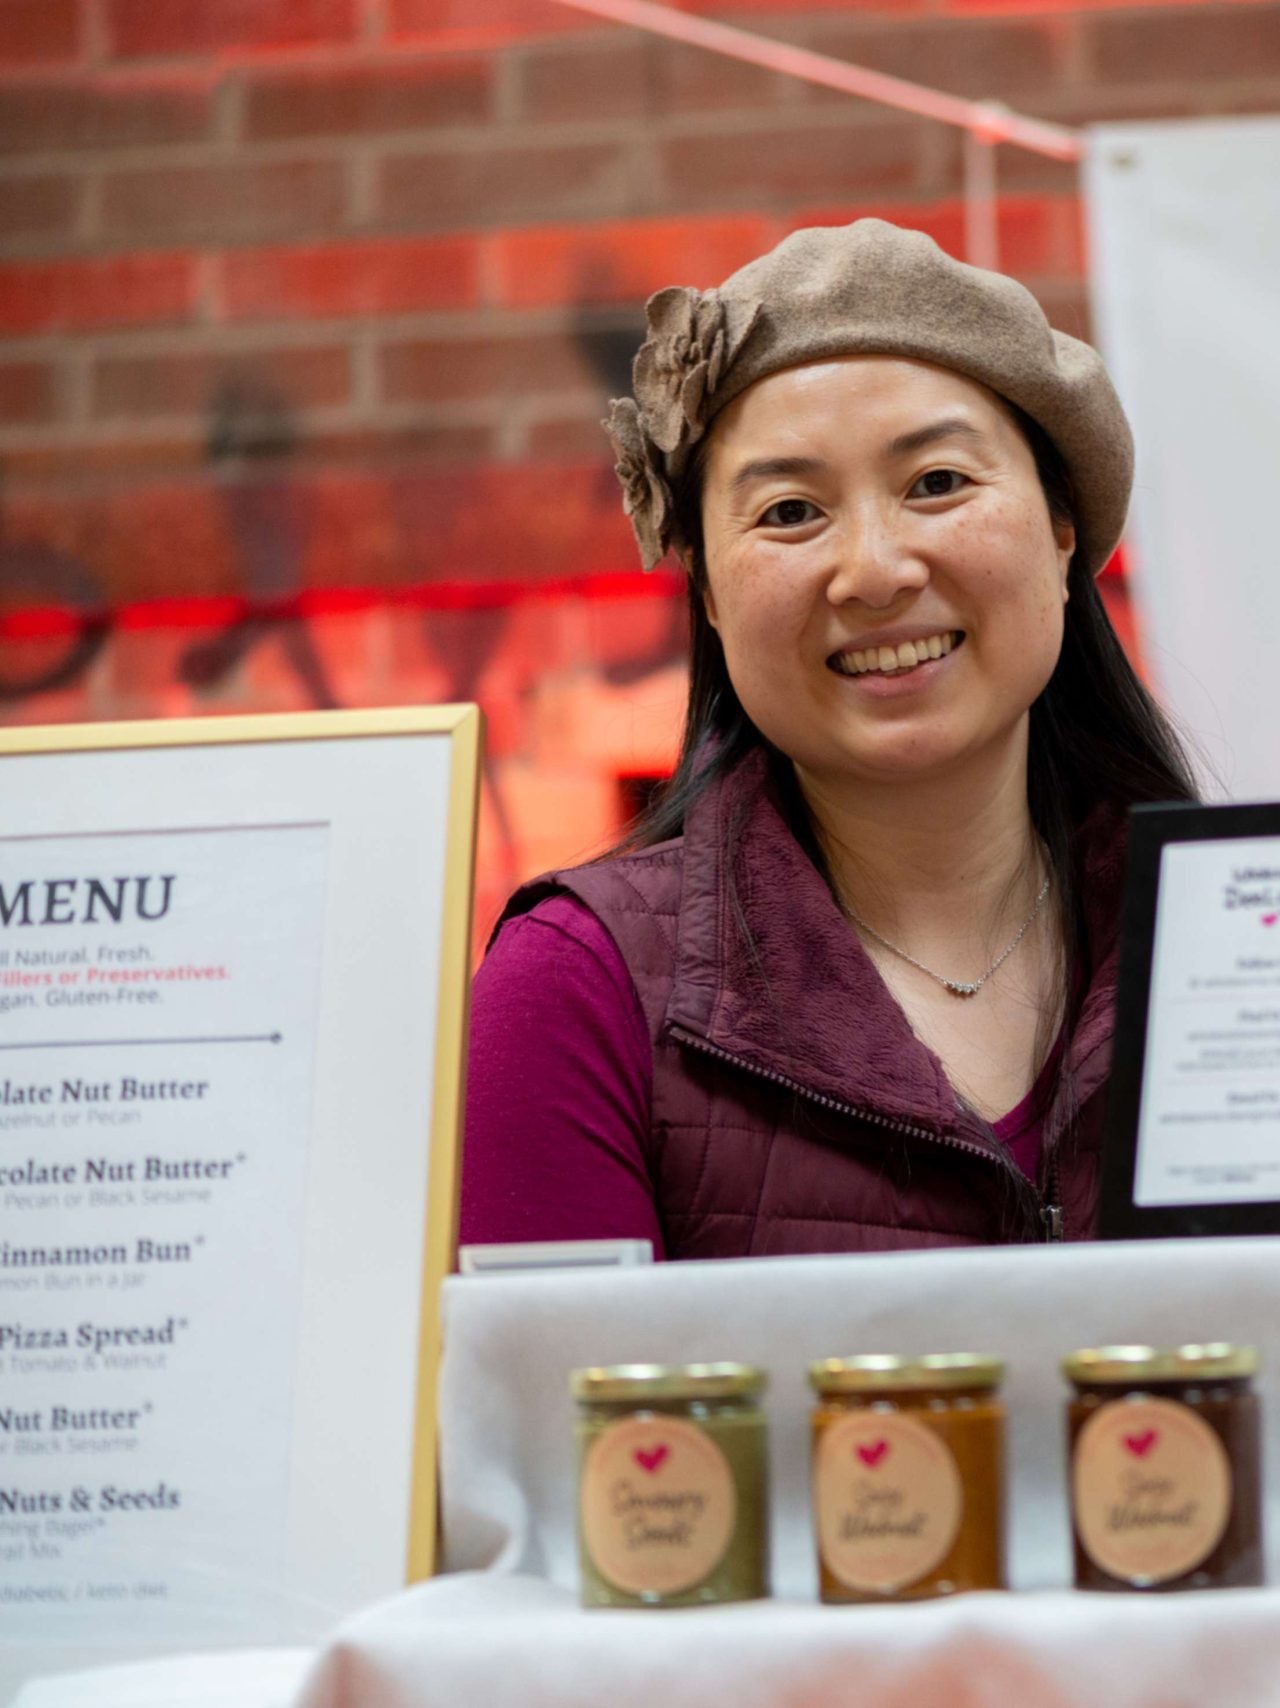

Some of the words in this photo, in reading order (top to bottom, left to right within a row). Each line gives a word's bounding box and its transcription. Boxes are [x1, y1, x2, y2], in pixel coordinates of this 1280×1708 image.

[0, 874, 177, 928] MENU
[0, 968, 53, 988] illers
[59, 972, 81, 986] or
[87, 963, 231, 984] Preservatives.
[46, 986, 163, 1008] Gluten-Free.
[0, 1079, 53, 1105] late
[61, 1078, 111, 1103] Nut
[119, 1077, 209, 1101] Butter
[84, 1156, 135, 1184] Nut
[0, 1241, 127, 1267] innamon
[0, 1321, 68, 1350] Pizza
[0, 1486, 62, 1513] Nuts
[69, 1485, 91, 1512] &
[99, 1481, 181, 1511] Seeds
